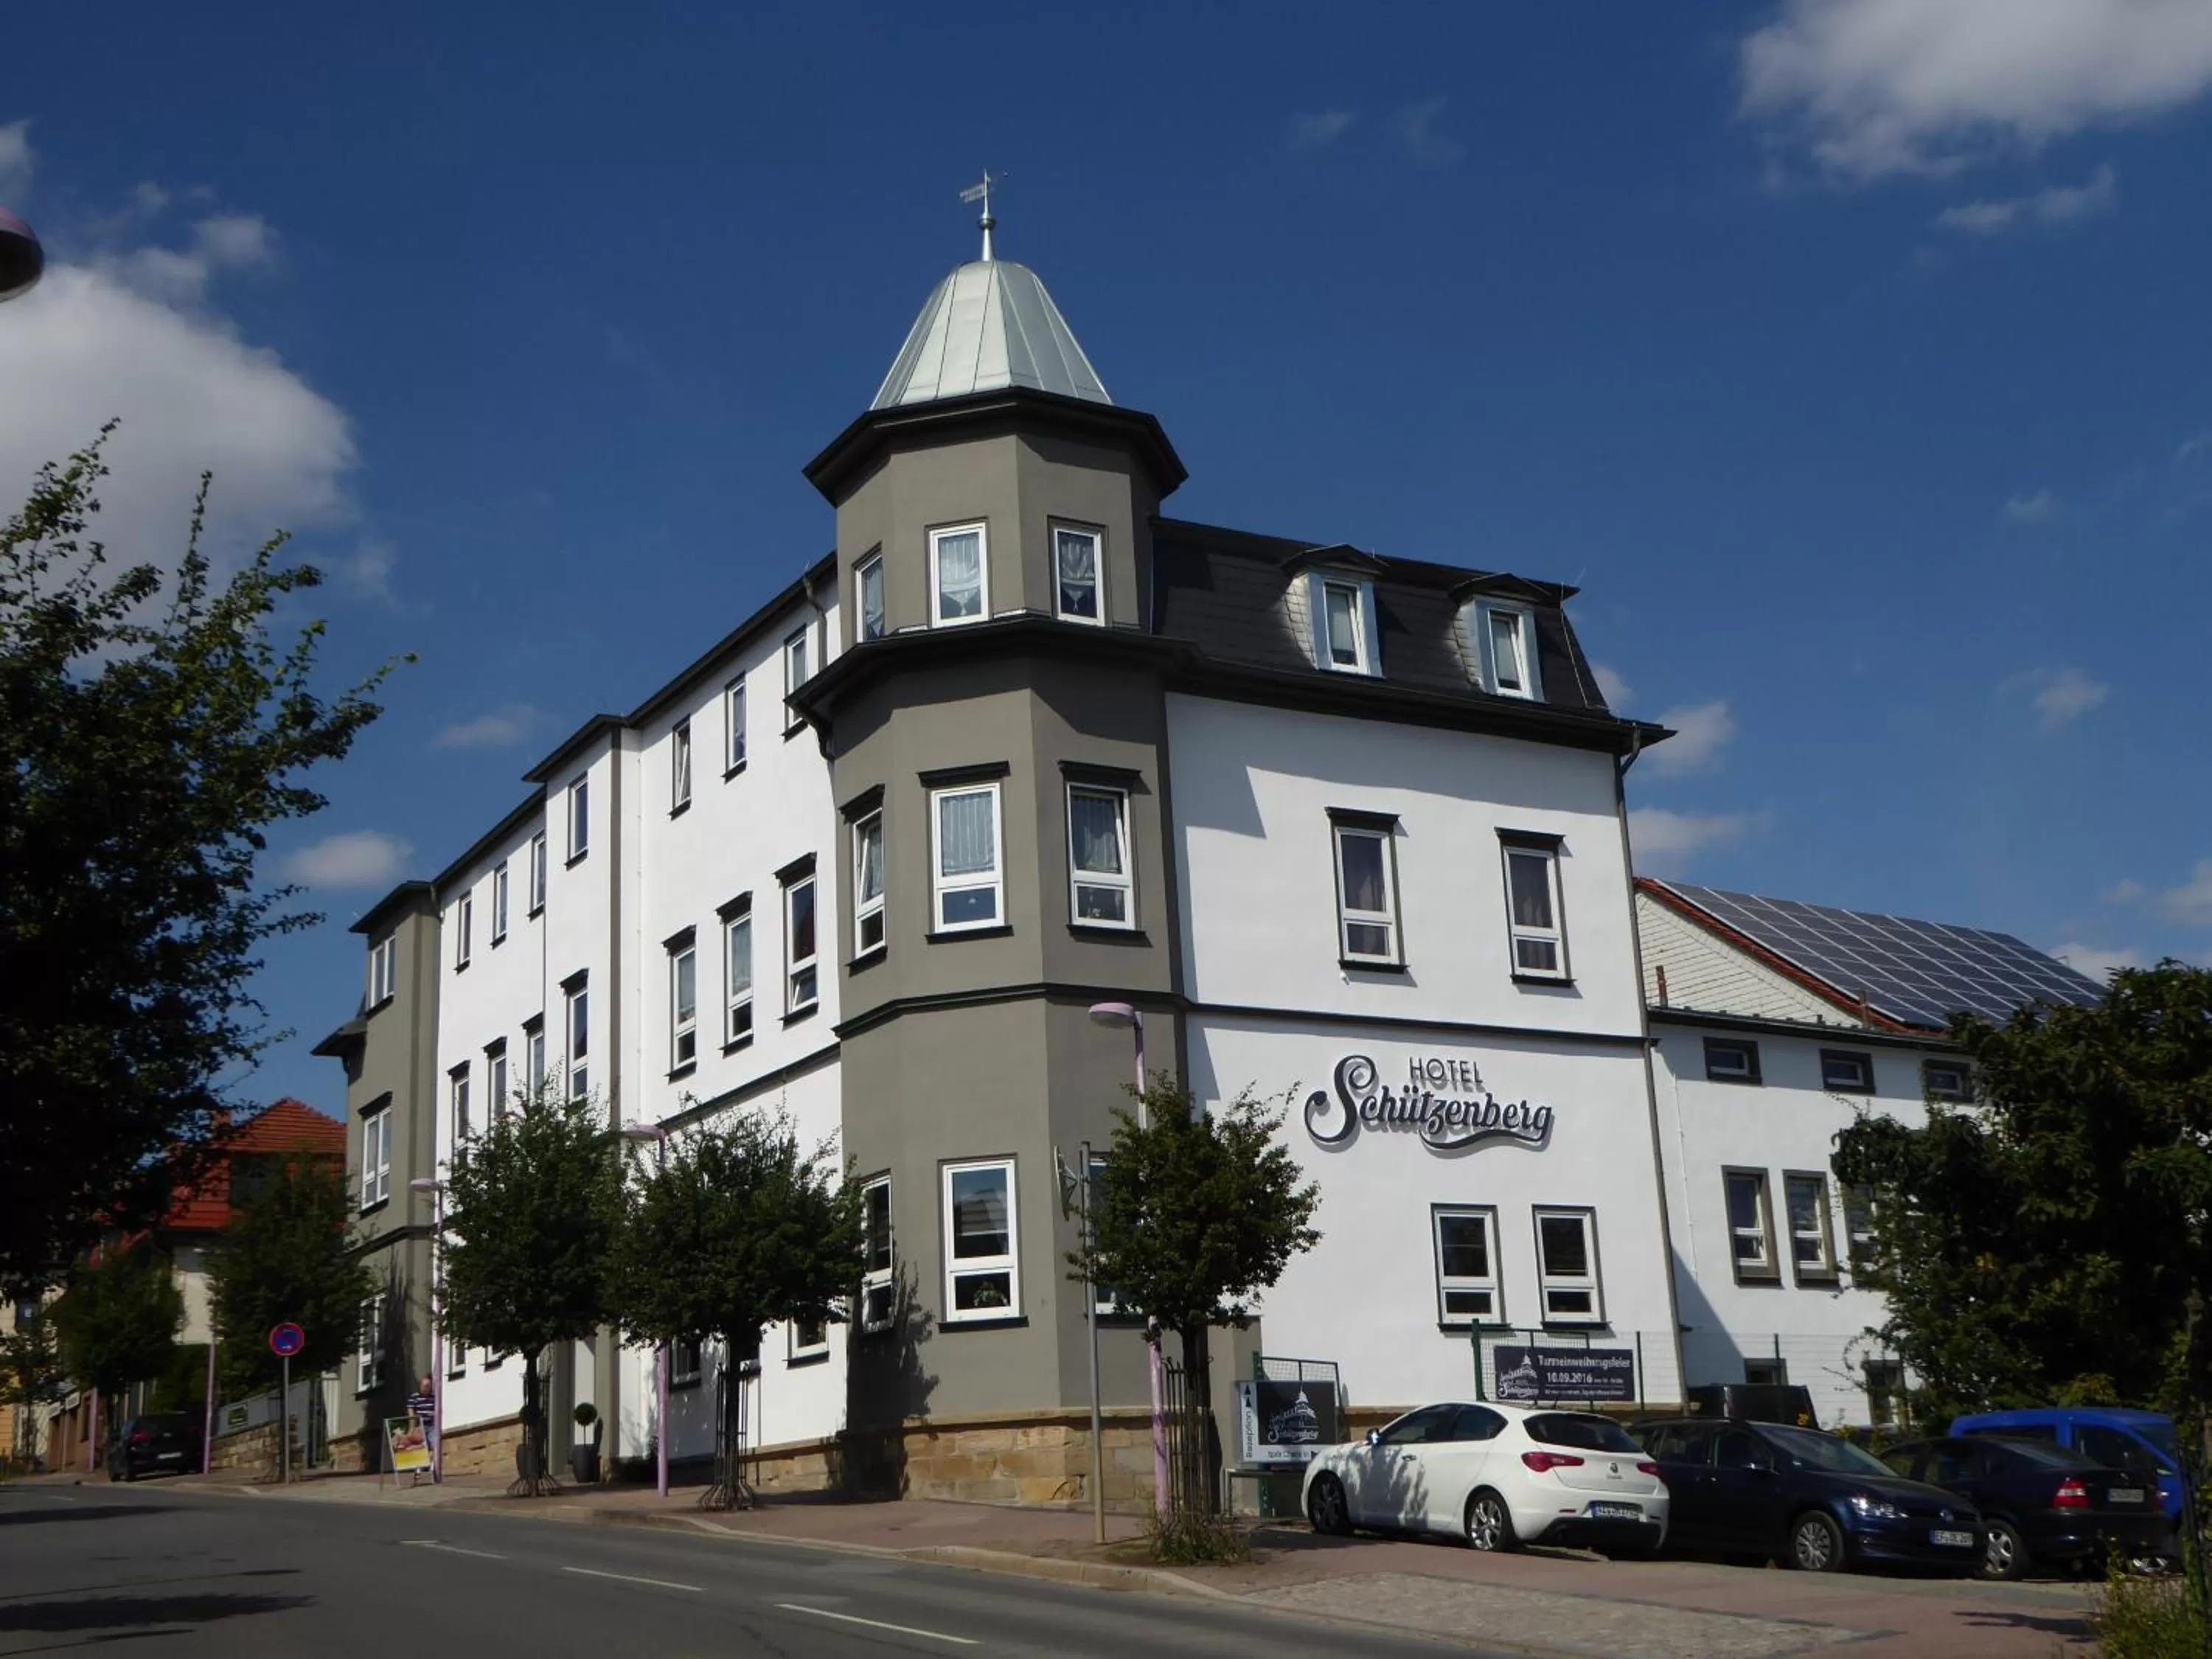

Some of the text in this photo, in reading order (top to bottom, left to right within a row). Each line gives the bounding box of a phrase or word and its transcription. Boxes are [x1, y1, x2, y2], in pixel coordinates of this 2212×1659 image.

[1409, 1057, 1484, 1083] HOTEL
[1304, 1055, 1553, 1150] Schützenberg
[1546, 1371, 1593, 1383] 10.09.2016
